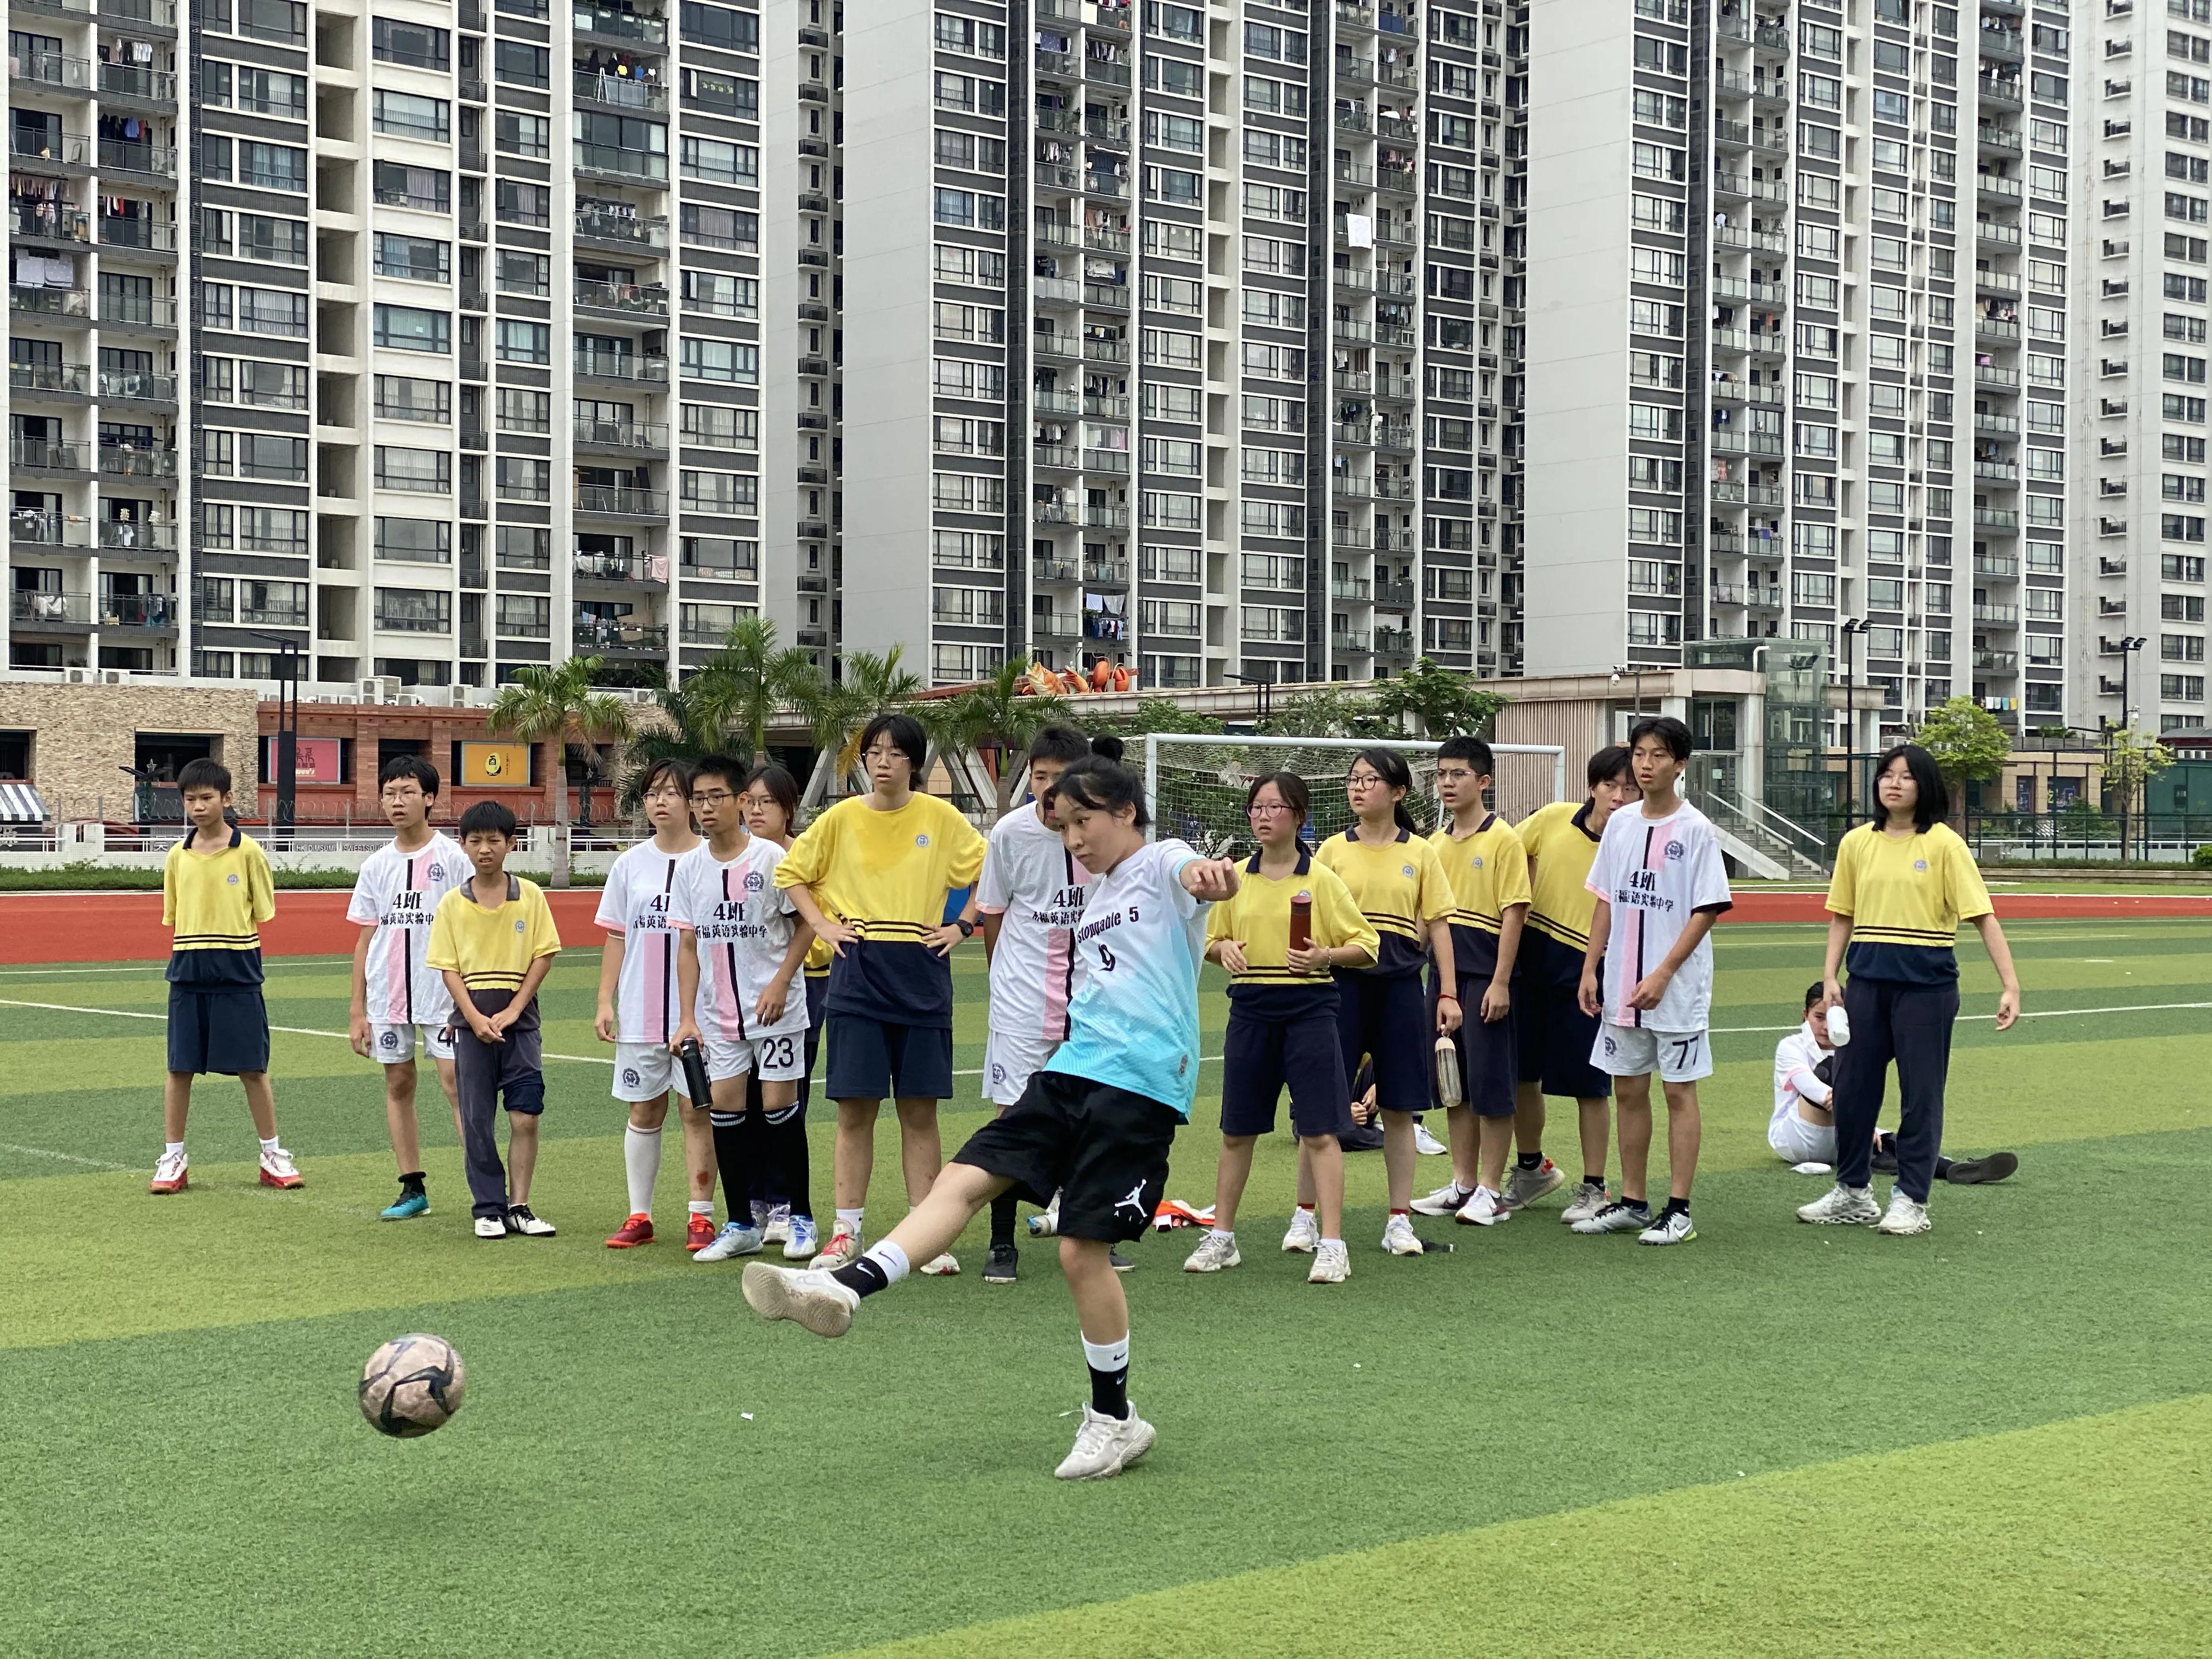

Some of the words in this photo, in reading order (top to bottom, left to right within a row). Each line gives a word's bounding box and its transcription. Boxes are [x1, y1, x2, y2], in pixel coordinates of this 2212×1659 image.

[392, 891, 423, 910] 4班
[1053, 885, 1086, 908] 4班
[1615, 889, 1674, 912] 福语实验中学
[713, 901, 746, 922] 4班
[1129, 906, 1139, 922] 5
[763, 1037, 794, 1069] 23
[1672, 1035, 1699, 1070] 77
